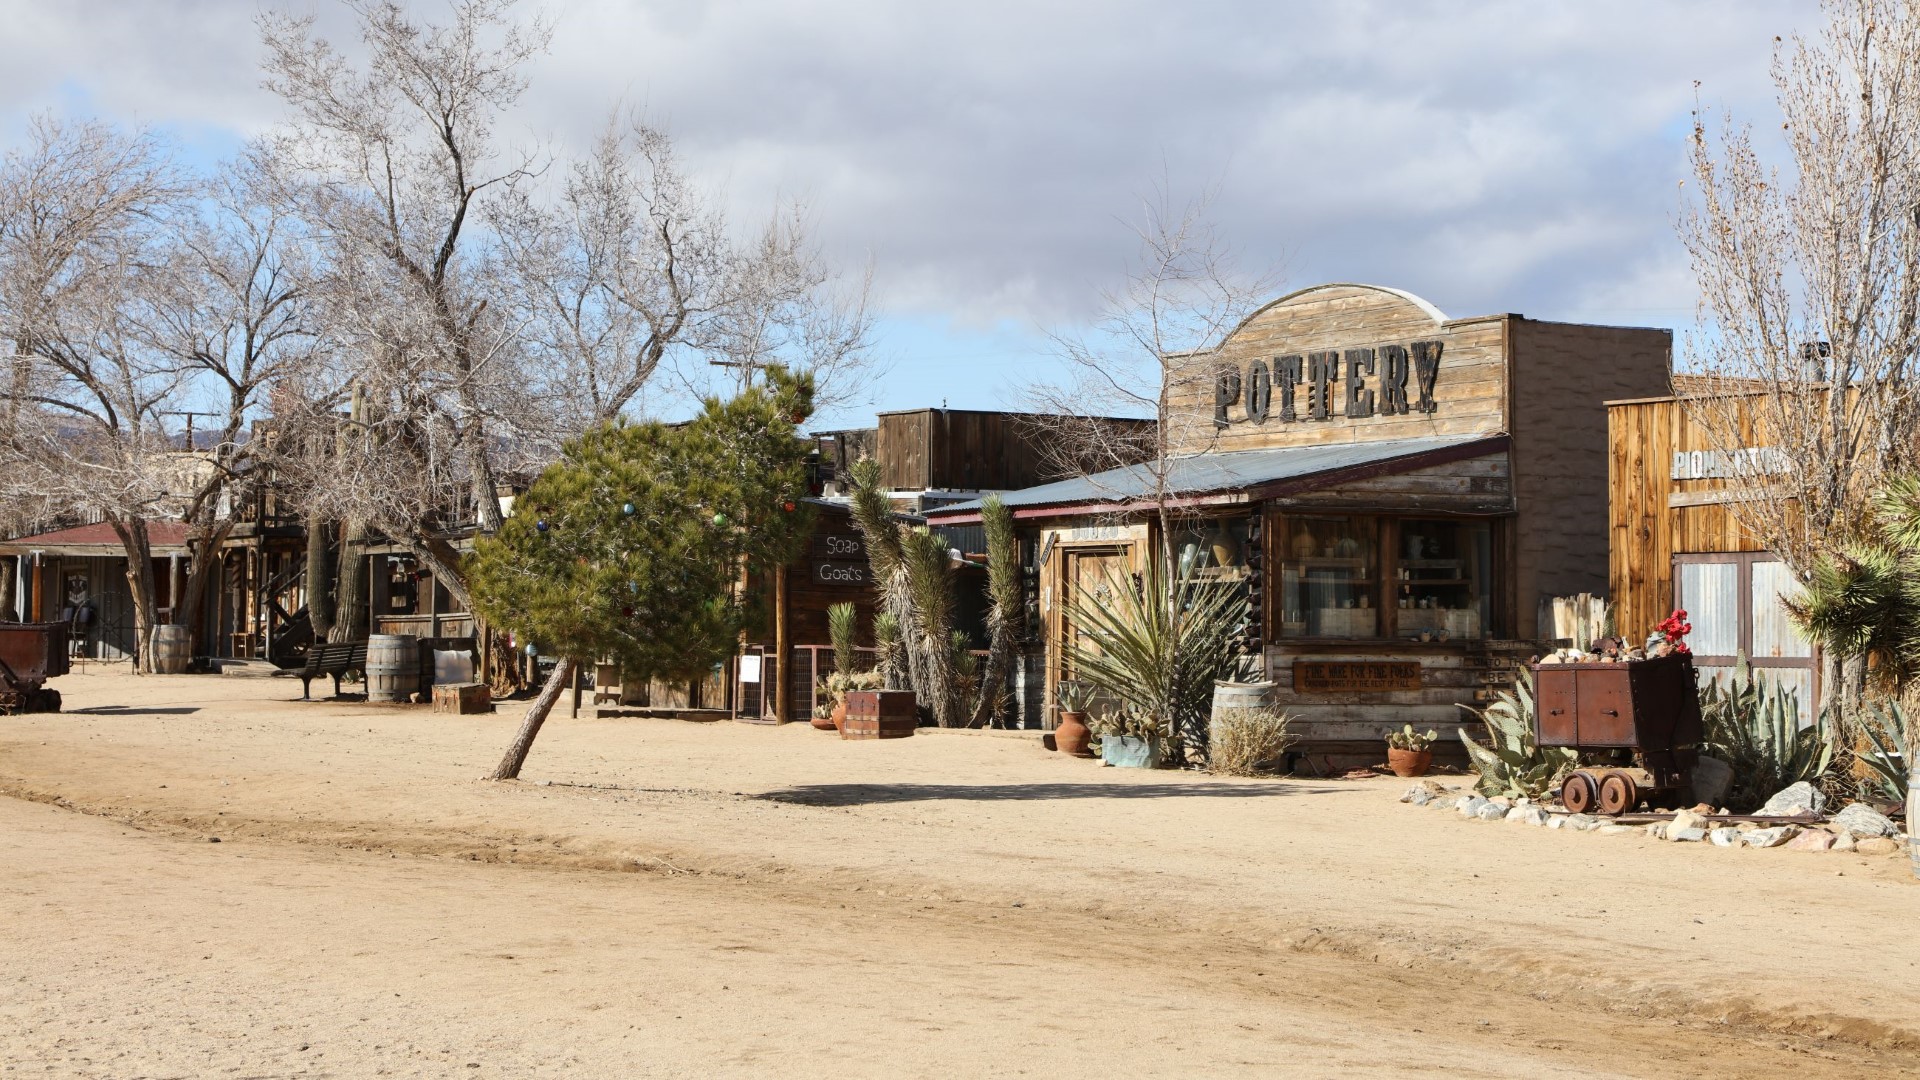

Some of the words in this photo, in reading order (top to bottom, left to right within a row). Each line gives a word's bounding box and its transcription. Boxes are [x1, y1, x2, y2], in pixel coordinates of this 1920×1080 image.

[1213, 340, 1444, 430] POTTERY
[826, 536, 859, 555] Soap
[1305, 664, 1325, 678] FINE
[1328, 664, 1347, 678] WARE
[1350, 664, 1365, 678] FOR
[1368, 664, 1388, 678] FINE
[1488, 672, 1506, 683] BE
